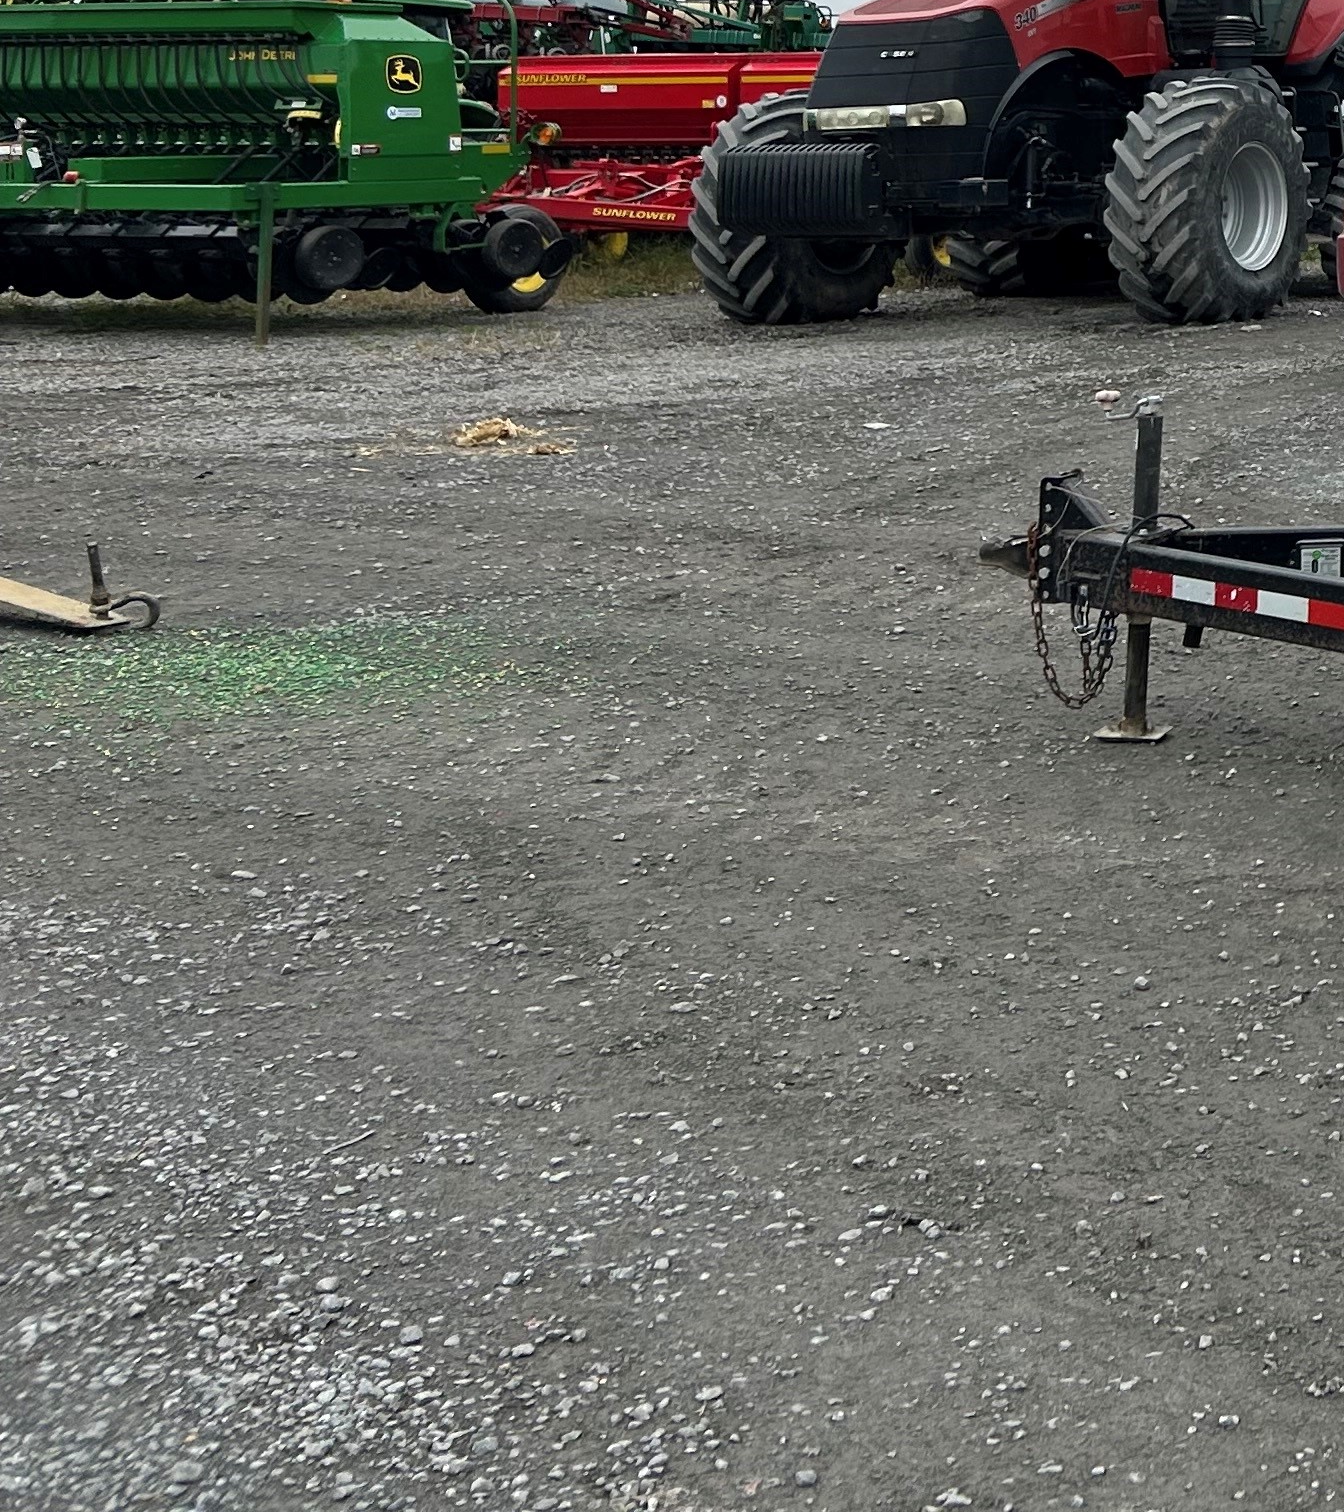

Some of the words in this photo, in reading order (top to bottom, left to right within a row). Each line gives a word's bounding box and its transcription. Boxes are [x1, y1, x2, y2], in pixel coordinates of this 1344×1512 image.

[1014, 5, 1038, 32] 340
[516, 74, 588, 84] SUNFLOWER
[592, 206, 677, 222] SUNFLOWER
